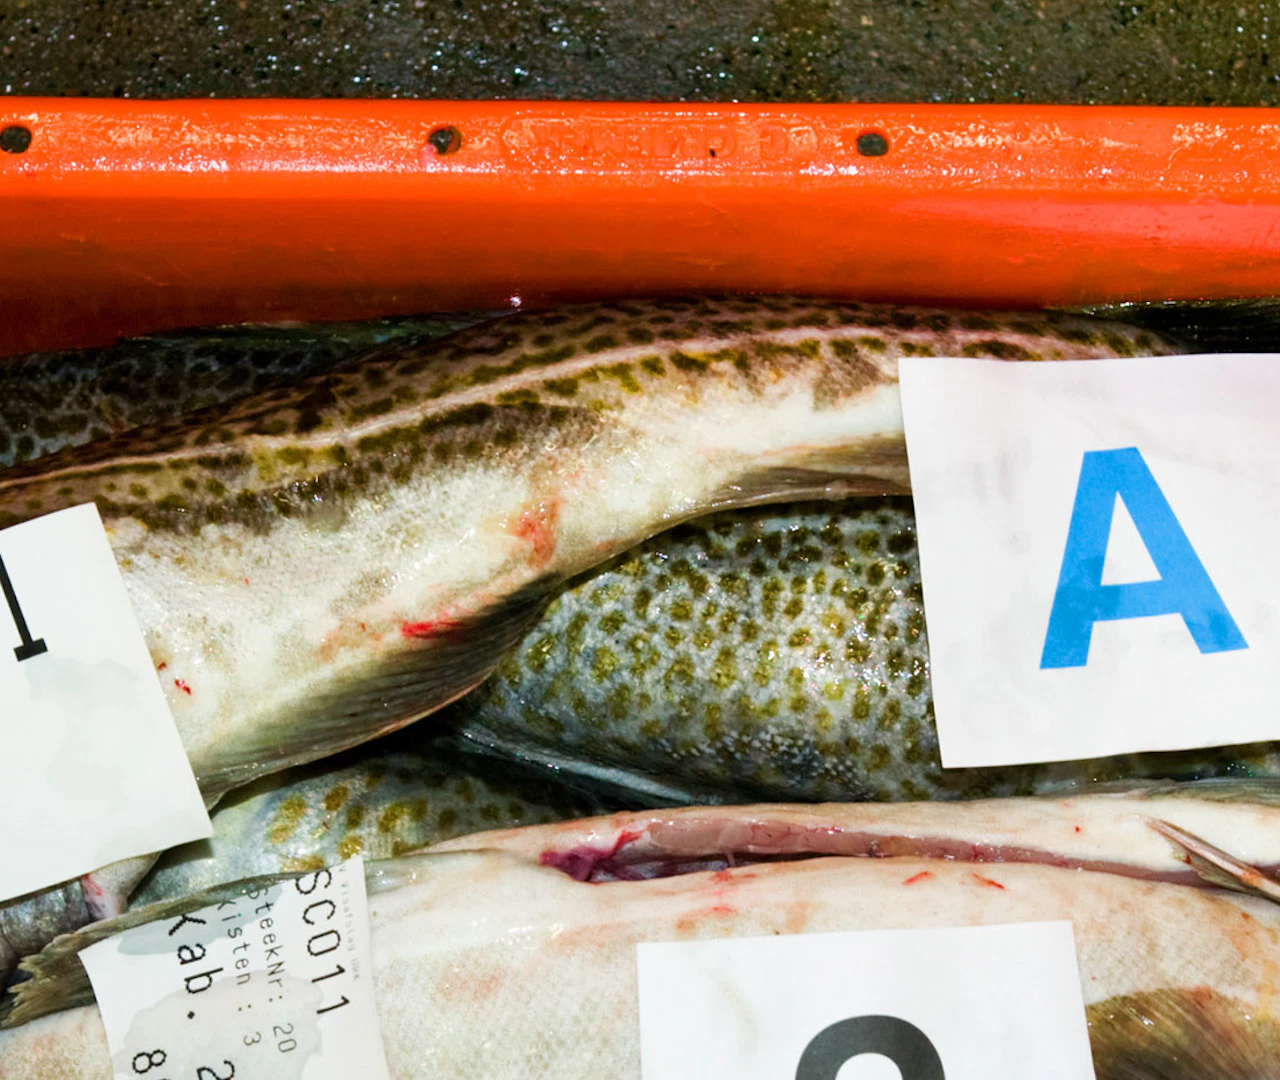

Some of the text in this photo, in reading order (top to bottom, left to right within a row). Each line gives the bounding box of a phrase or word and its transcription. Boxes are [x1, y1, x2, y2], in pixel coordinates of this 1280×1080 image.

[1039, 447, 1249, 669] A
[295, 869, 350, 1014] SC011
[243, 1031, 262, 1047] 3
[273, 1022, 298, 1053] 20
